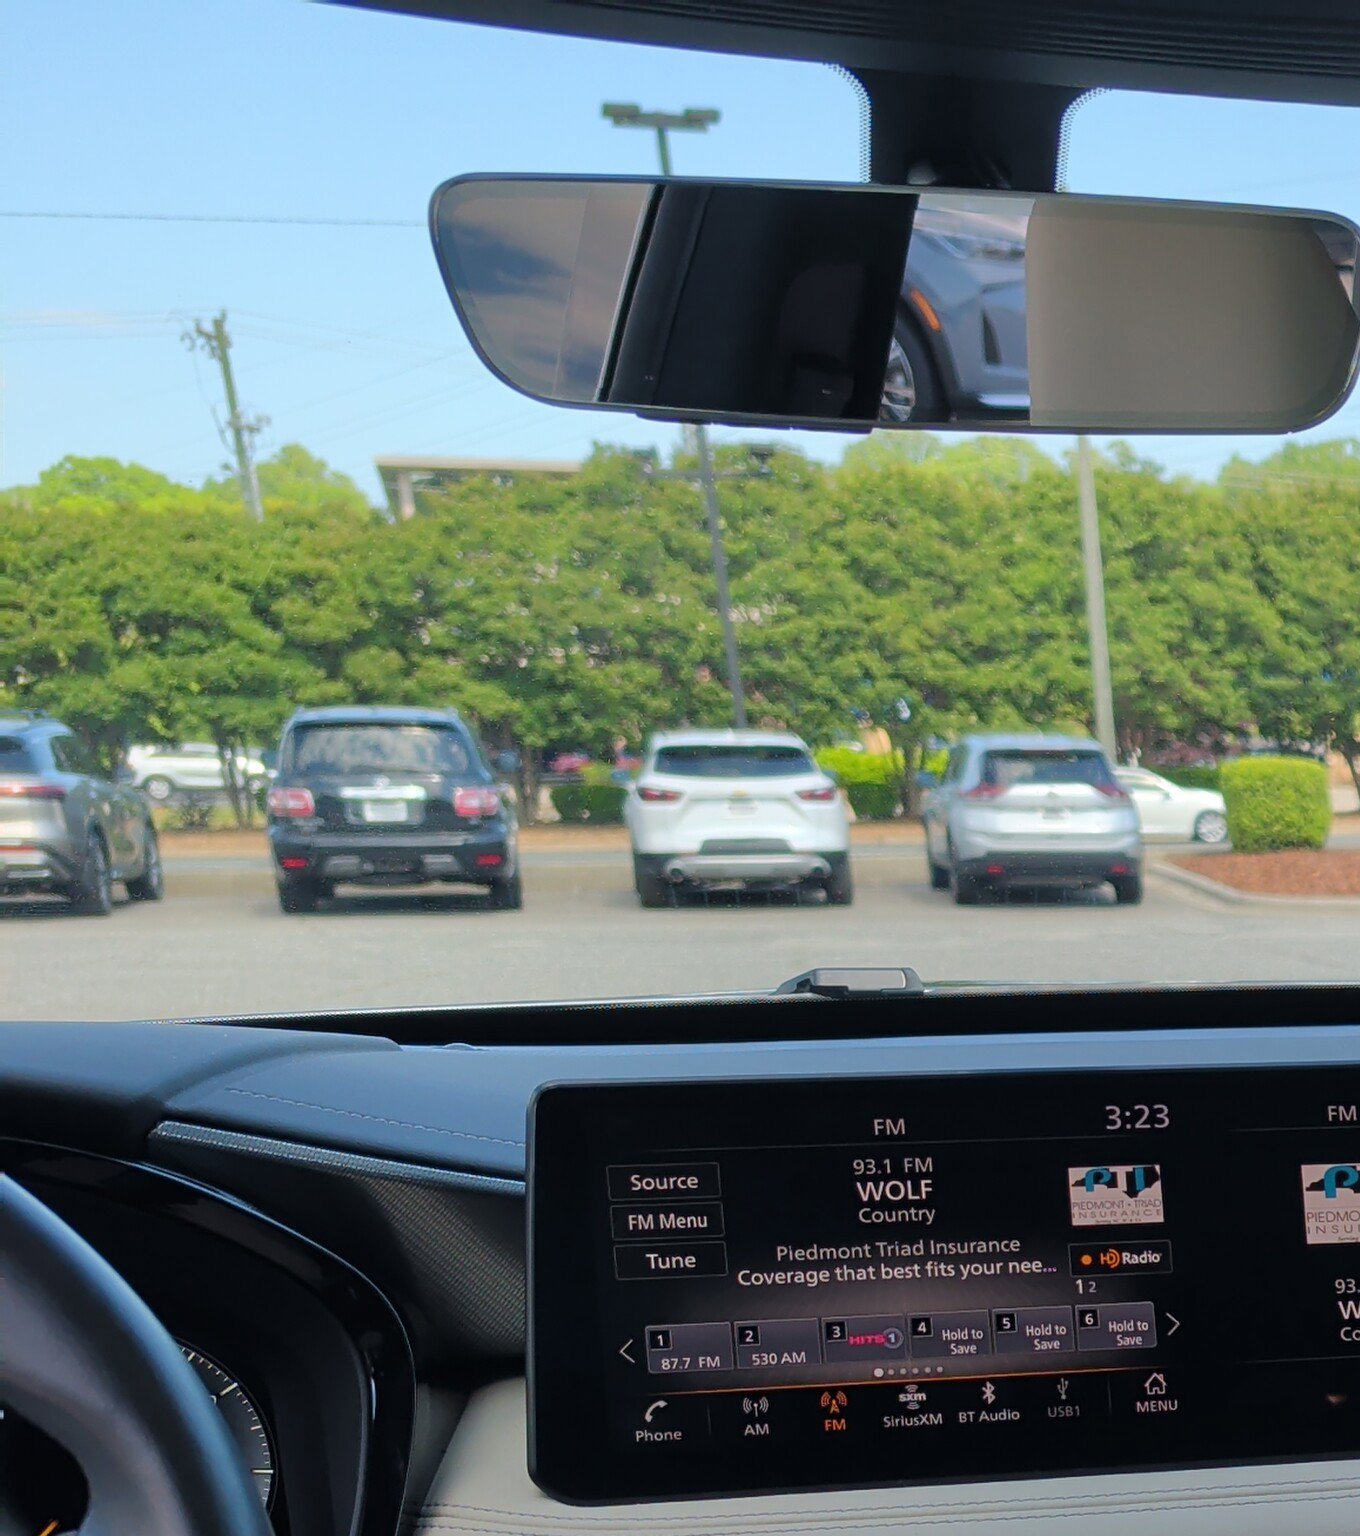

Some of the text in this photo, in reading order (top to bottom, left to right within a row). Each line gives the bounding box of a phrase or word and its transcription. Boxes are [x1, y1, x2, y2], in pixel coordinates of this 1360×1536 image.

[1104, 1104, 1171, 1130] 3:23
[1327, 1105, 1358, 1122] FM
[873, 1118, 906, 1136] FM
[852, 1157, 934, 1175] 93.1 FM
[630, 1174, 699, 1191] Source
[856, 1179, 934, 1202] WOLF
[1072, 1199, 1162, 1211] PIEDMONT TRIAD
[858, 1207, 936, 1226] Country
[1072, 1208, 1162, 1219] INSURANCE
[628, 1212, 708, 1231] FM Menu
[776, 1238, 1020, 1262] Piedmont Triad Insurance
[645, 1253, 697, 1270] Tune
[1121, 1250, 1161, 1265] Radio
[737, 1267, 831, 1287] Coverage
[833, 1264, 876, 1282] that
[876, 1261, 920, 1280] best
[925, 1260, 956, 1278] fits
[960, 1261, 1004, 1281] your
[1076, 1278, 1097, 1294] 1 2
[1002, 1317, 1011, 1330] 5
[1084, 1313, 1094, 1325] 6
[831, 1325, 841, 1338] 3
[917, 1321, 927, 1334] 4
[1026, 1324, 1067, 1337] Hold to
[1108, 1320, 1149, 1333] Hold to
[657, 1334, 664, 1347] 1
[745, 1330, 755, 1343] 2
[941, 1328, 984, 1341] Hold to
[1116, 1335, 1143, 1347] Save
[950, 1343, 977, 1356] Save
[1033, 1338, 1061, 1351] Save
[661, 1356, 721, 1370] 87.7 FM
[751, 1352, 807, 1366] 530 AM
[1047, 1405, 1081, 1418] USB1
[1136, 1399, 1179, 1414] MENU
[883, 1413, 943, 1428] SiriusXM
[958, 1408, 1021, 1423] BT Audio
[744, 1424, 770, 1437] AM
[824, 1419, 847, 1431] FM
[635, 1430, 683, 1443] Phone
